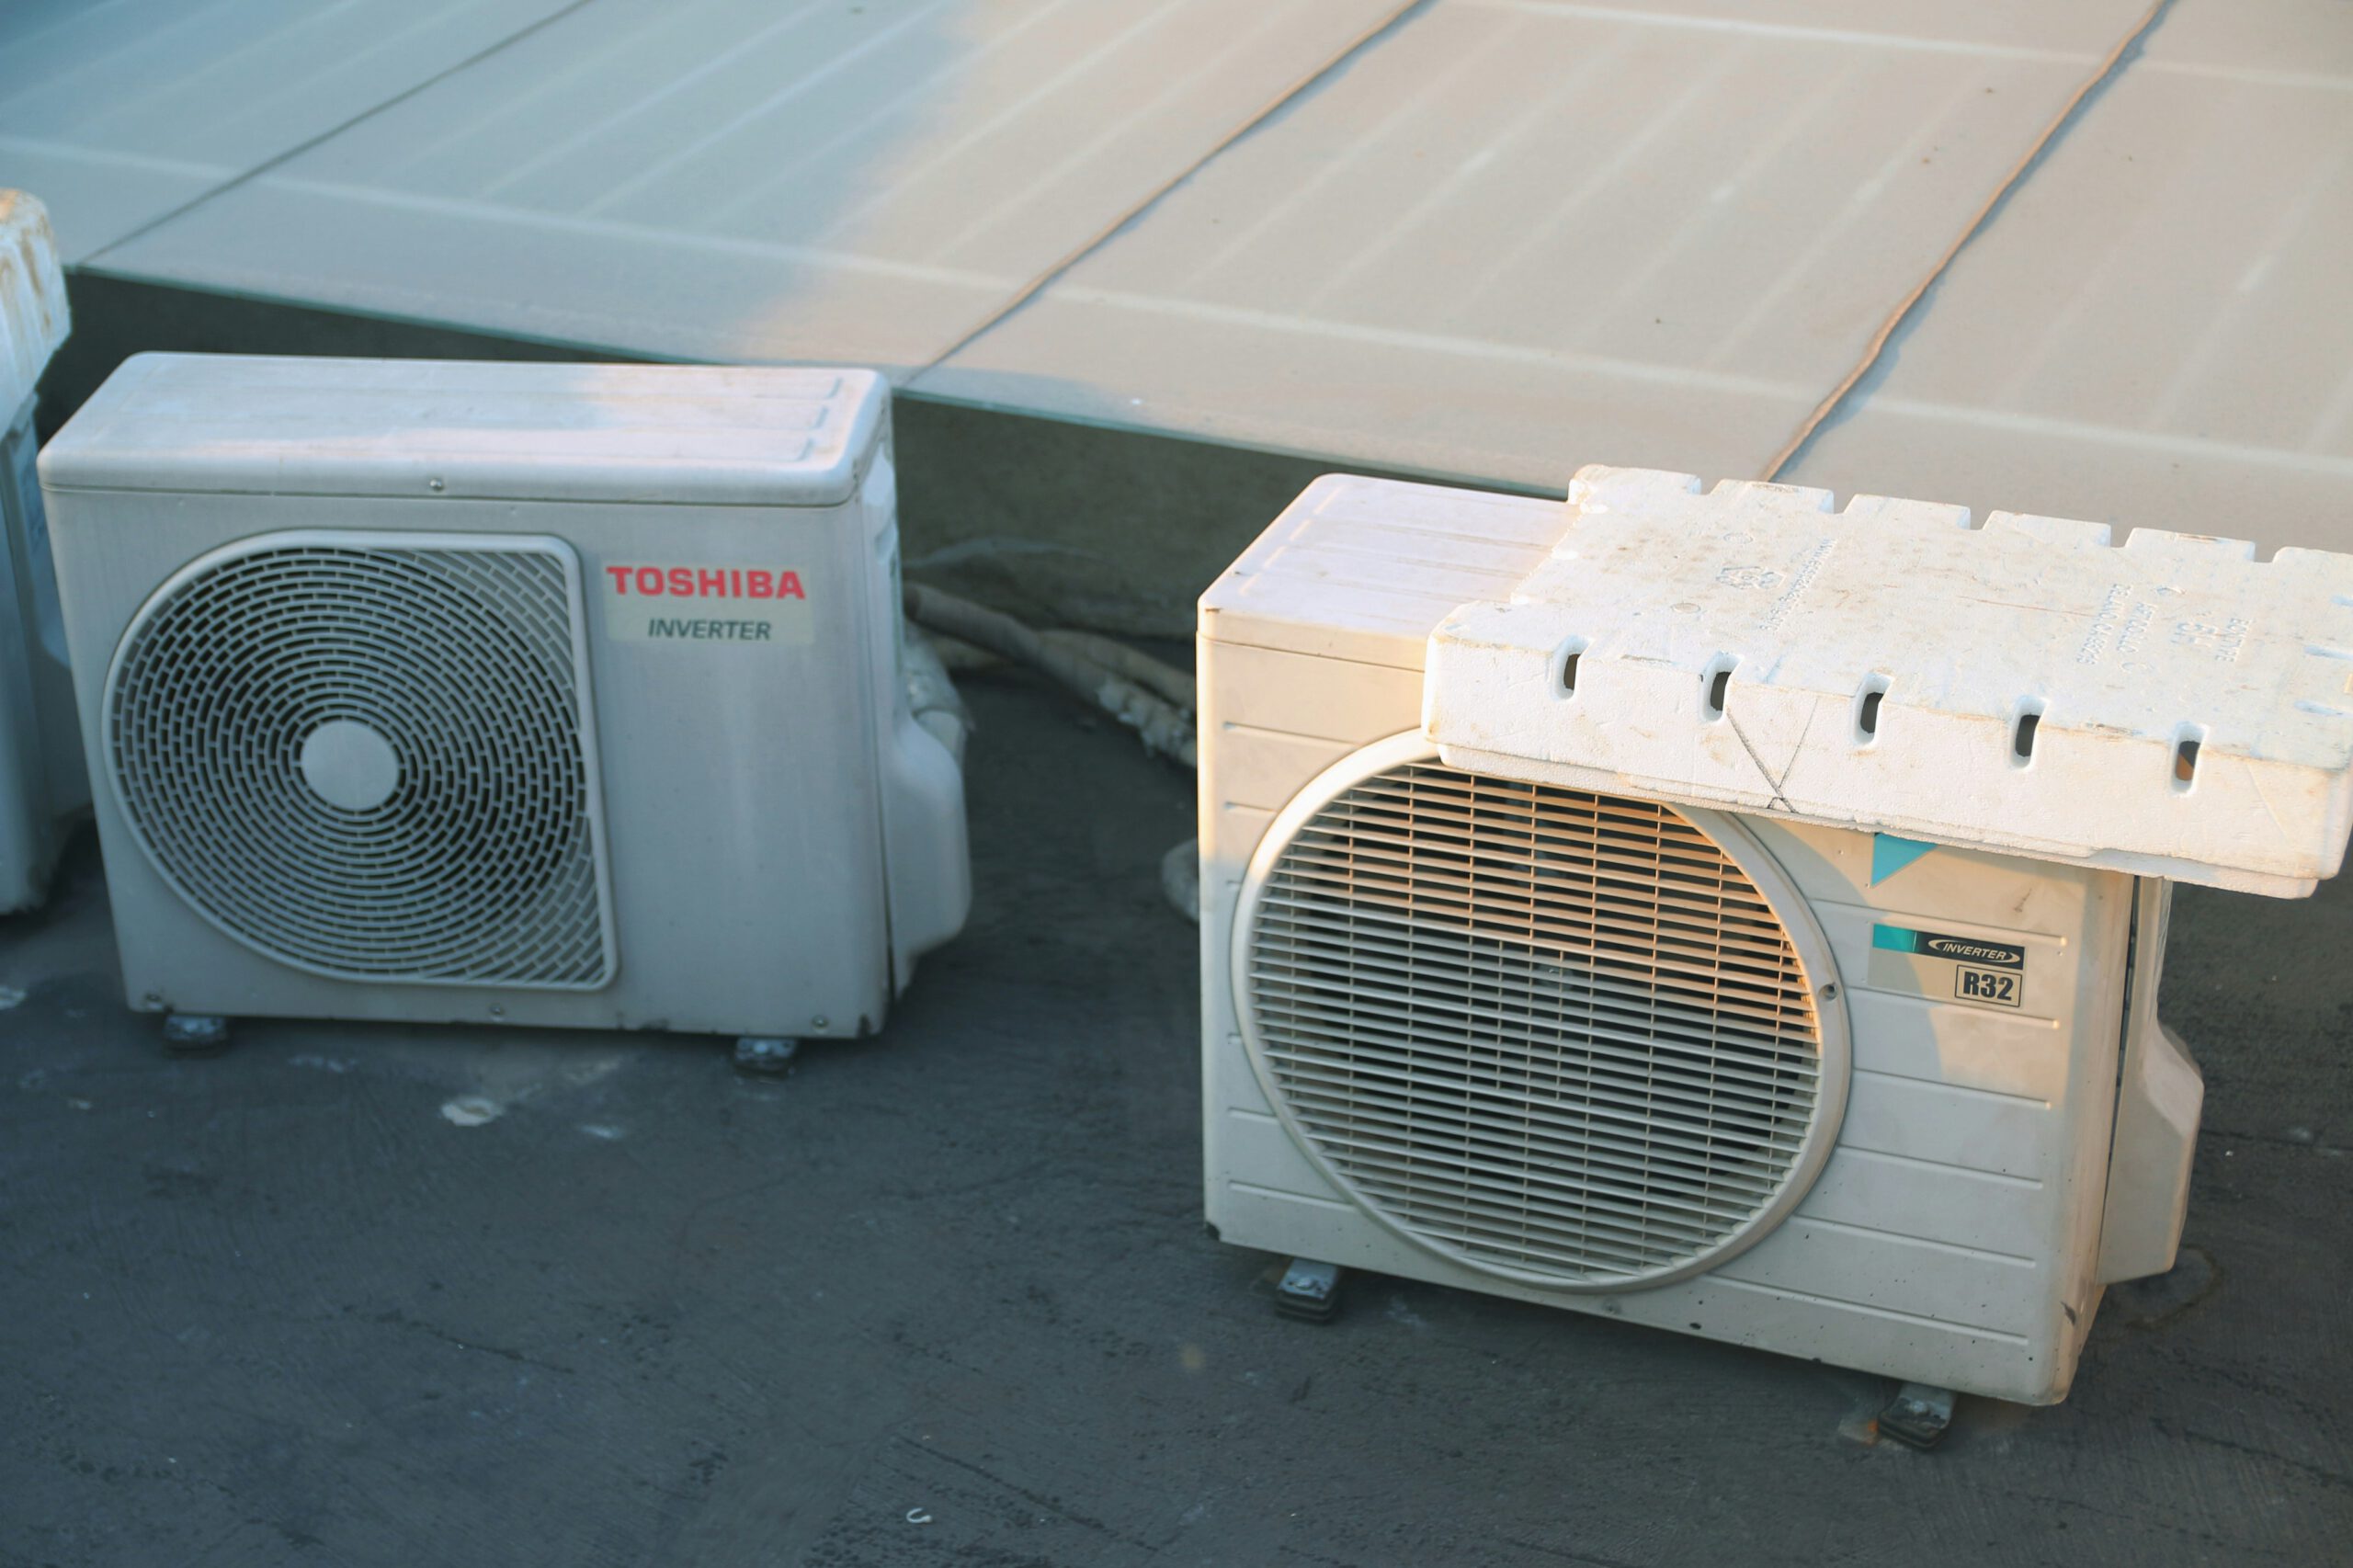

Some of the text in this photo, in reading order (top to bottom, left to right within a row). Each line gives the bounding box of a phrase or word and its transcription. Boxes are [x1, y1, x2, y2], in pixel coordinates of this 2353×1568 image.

[606, 566, 806, 599] TOSHIBA
[648, 618, 772, 641] INVERTER
[1942, 942, 2006, 960] INVERTER
[1962, 971, 2014, 1001] R32
